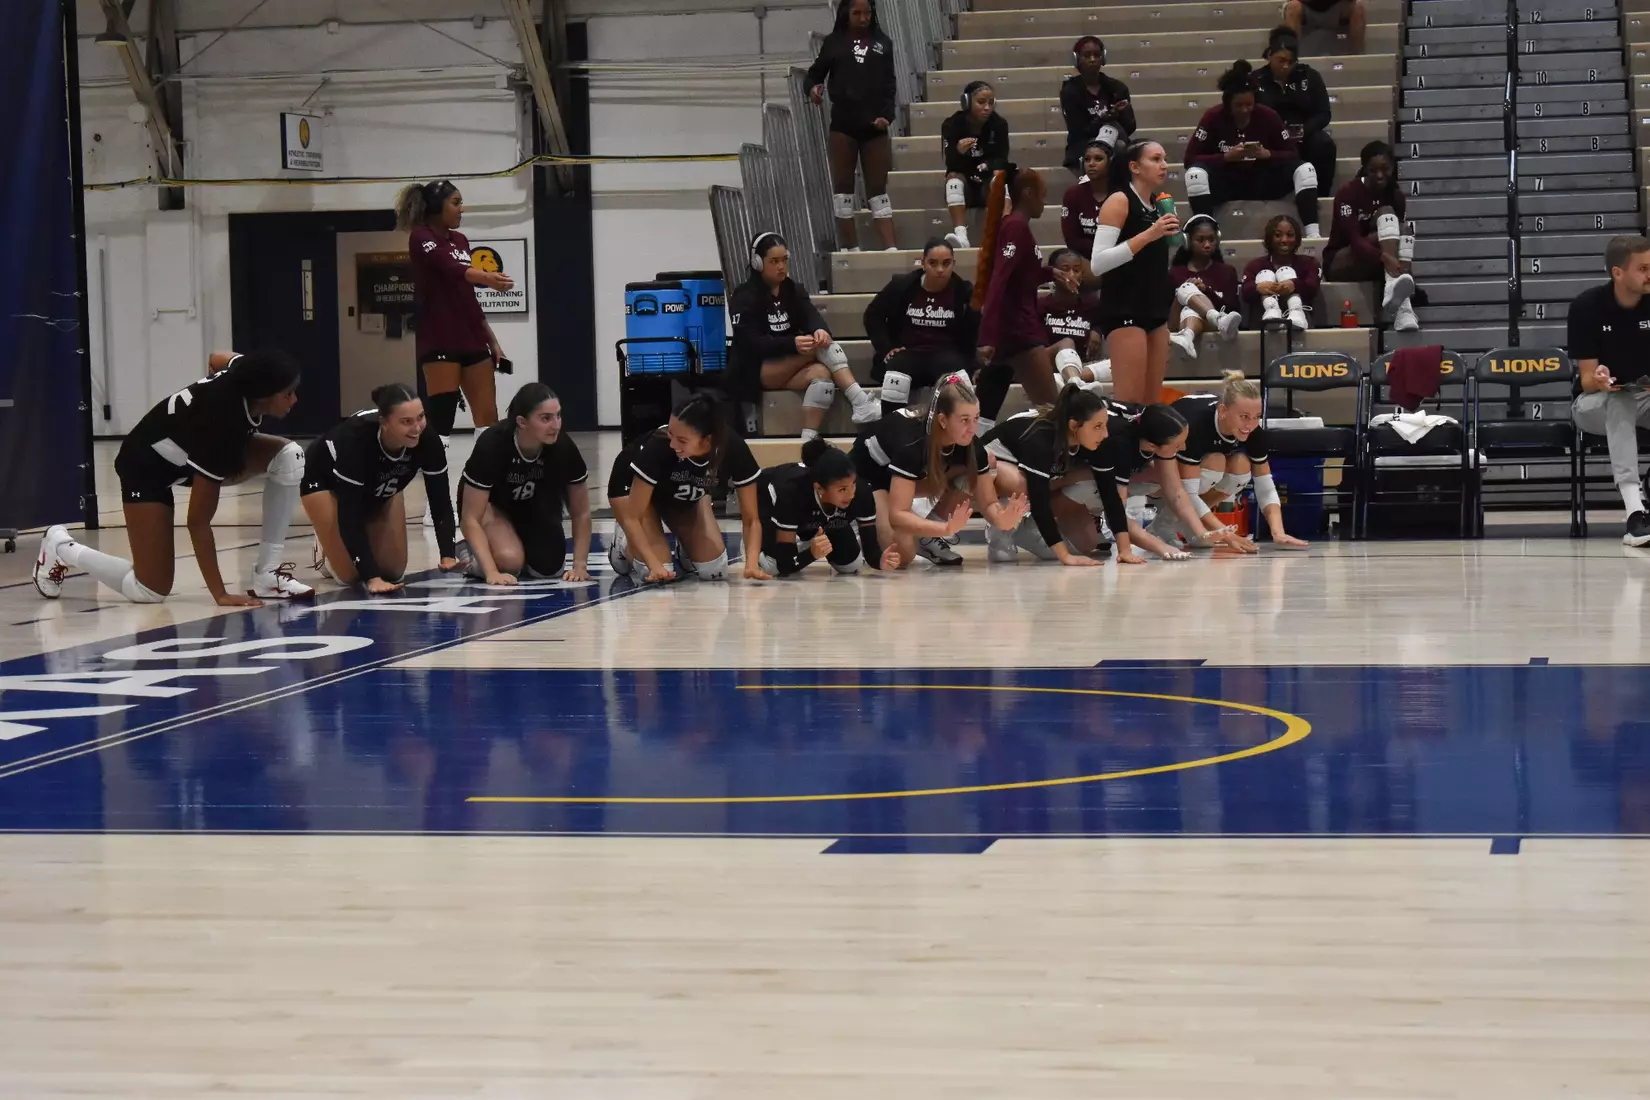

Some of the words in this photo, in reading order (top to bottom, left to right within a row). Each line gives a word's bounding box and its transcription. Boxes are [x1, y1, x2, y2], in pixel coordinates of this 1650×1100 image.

[1425, 17, 1432, 27] A
[1530, 12, 1541, 23] 12
[1585, 9, 1592, 20] B
[1420, 46, 1427, 57] A
[1526, 41, 1535, 52] 11
[1417, 77, 1424, 88] A
[1537, 72, 1547, 83] 10
[1589, 70, 1596, 81] B
[1415, 109, 1422, 121] A
[1535, 104, 1542, 115] 9
[1583, 103, 1589, 114] B
[1411, 144, 1419, 157] A
[1540, 140, 1547, 151] 8
[1592, 138, 1599, 150] B
[1411, 182, 1419, 195] A
[1536, 178, 1543, 190] 7
[1536, 218, 1543, 231] 6
[1596, 216, 1603, 229] B
[1533, 259, 1540, 273] 5
[373, 283, 416, 293] CHAMPIONS
[1537, 305, 1544, 318] 4
[1280, 363, 1349, 379] LIONS
[1490, 358, 1561, 373] LIONS
[1533, 404, 1541, 420] 2
[375, 478, 399, 498] 15
[512, 481, 536, 500] 18
[674, 485, 706, 501] 20
